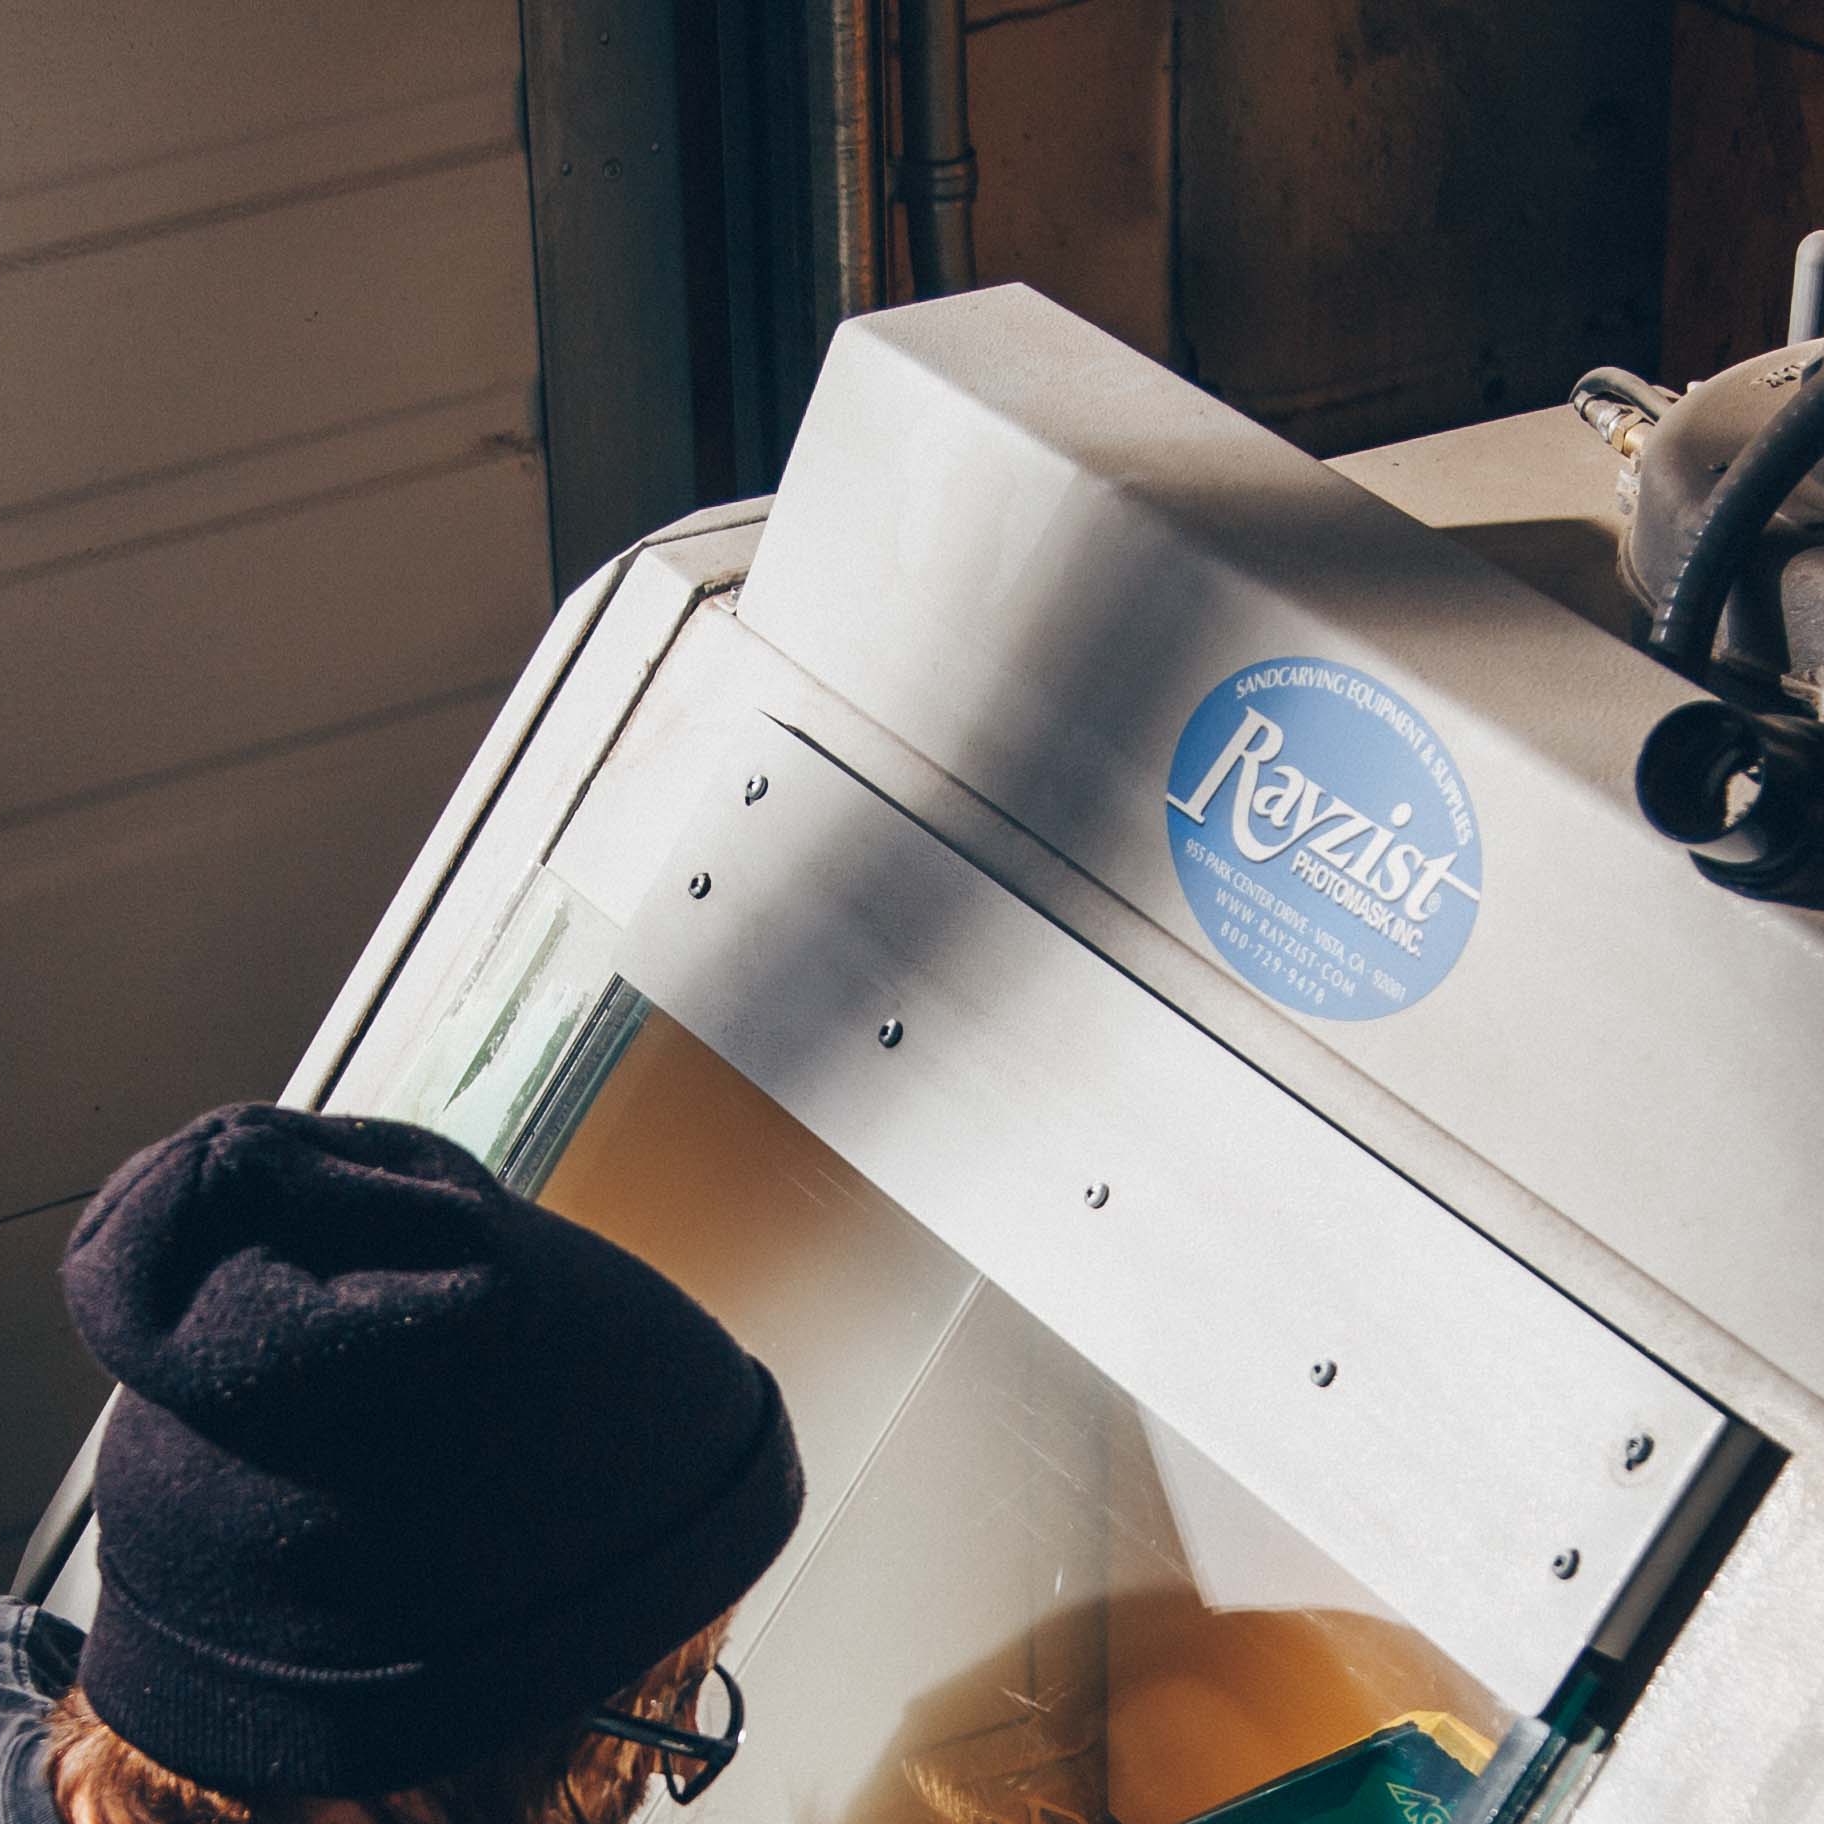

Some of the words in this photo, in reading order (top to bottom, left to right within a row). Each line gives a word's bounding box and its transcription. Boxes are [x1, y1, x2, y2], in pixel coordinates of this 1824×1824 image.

[1168, 705, 1476, 923] Rayzist
[1236, 666, 1348, 699] SANDCARVING
[1347, 679, 1427, 749] EQUIPMENT
[1421, 743, 1438, 763] &
[1432, 758, 1474, 847] SUPPLIES
[1185, 838, 1207, 863] 955
[1204, 849, 1235, 884] PARK
[1231, 871, 1276, 912] CENTER
[1274, 899, 1310, 936] DRIVE
[1348, 951, 1366, 976] CA
[1290, 849, 1395, 942] PHOTOMASK
[1390, 917, 1425, 959] INC.
